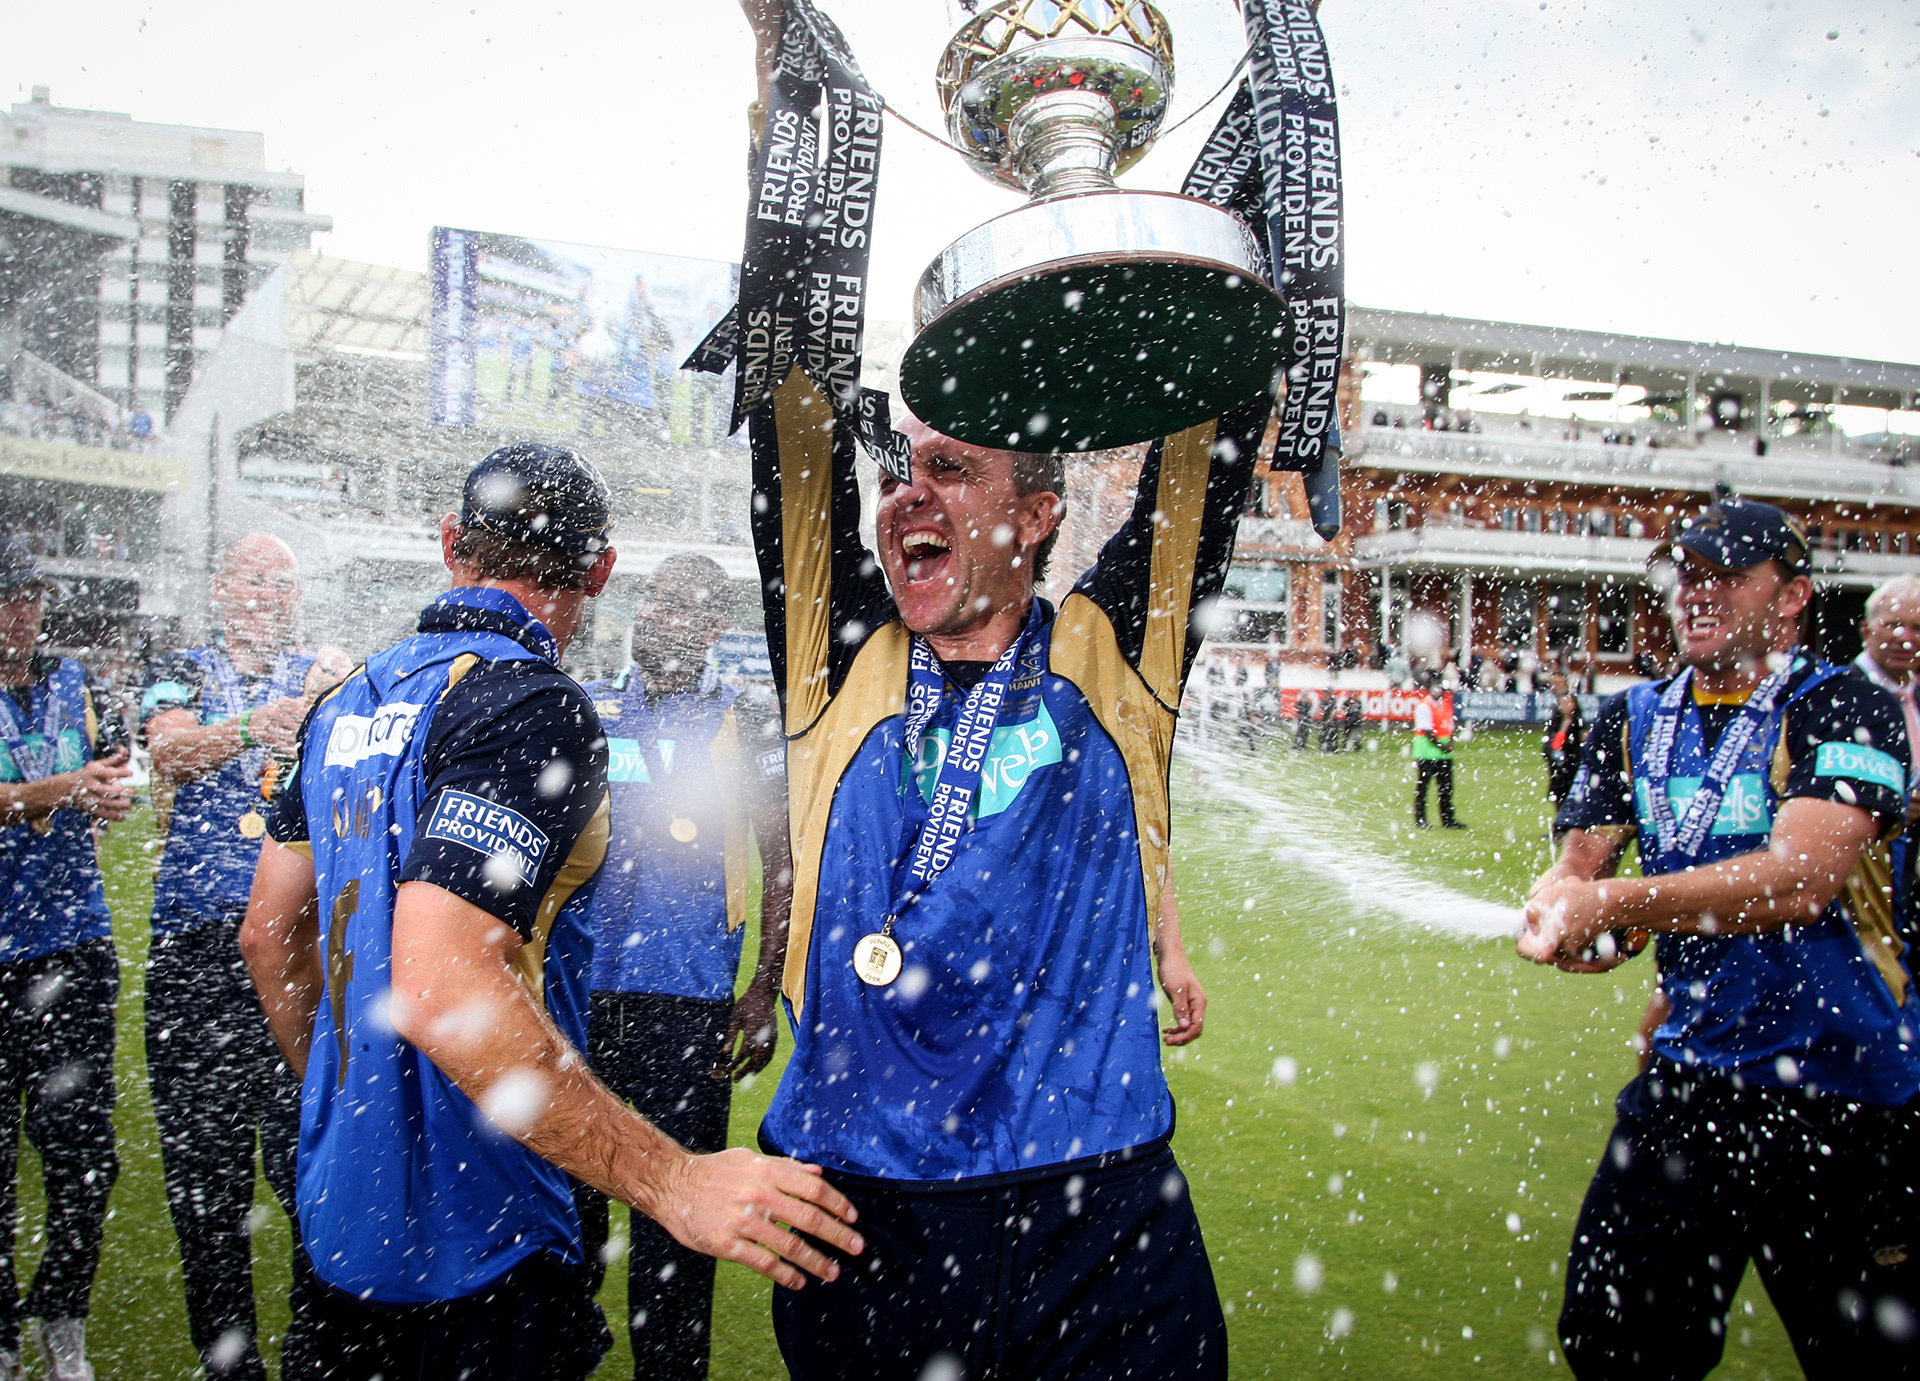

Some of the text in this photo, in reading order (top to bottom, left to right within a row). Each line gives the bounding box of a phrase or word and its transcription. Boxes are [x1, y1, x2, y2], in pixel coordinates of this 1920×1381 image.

[757, 109, 799, 223] FRIENDS
[785, 116, 818, 227] PROVIDENT
[820, 87, 852, 246] PROVIDENT
[840, 91, 880, 249] FRIENDS
[1184, 110, 1250, 198] RIENDS
[1285, 113, 1306, 268] PROVIDENT
[1309, 117, 1339, 268] FRIENDS
[739, 311, 771, 414] FRIENDS
[830, 274, 862, 415] FRIENDS
[1278, 300, 1311, 457] PROVIDENT
[1297, 296, 1339, 458] FRIENDS
[946, 682, 986, 768] PROVIDENT
[962, 682, 1005, 773] FRIENDS
[1707, 715, 1750, 779] FRIENDS
[435, 817, 535, 873] PROVIDENT
[442, 797, 544, 857] FRIENDS
[911, 782, 952, 880] PROVIDENT
[927, 786, 972, 882] FRIENDS
